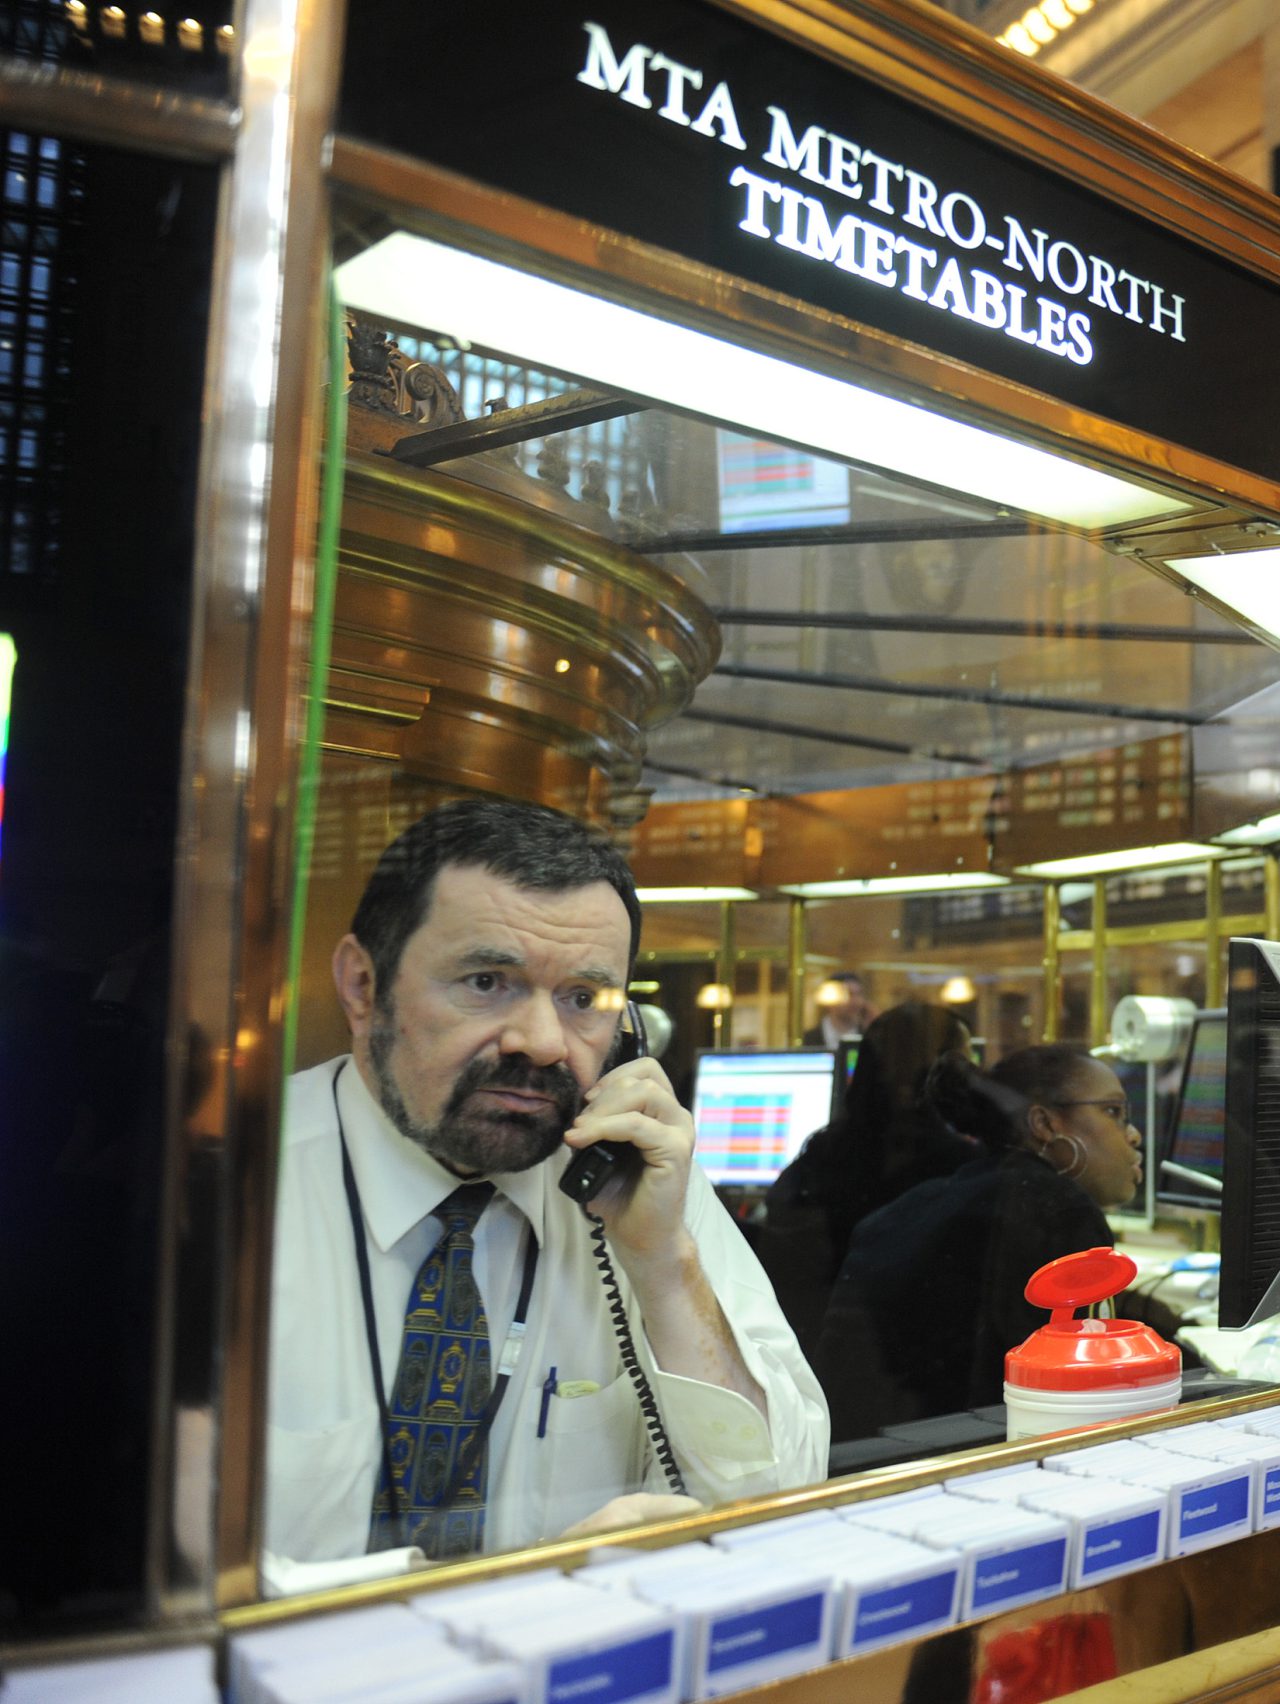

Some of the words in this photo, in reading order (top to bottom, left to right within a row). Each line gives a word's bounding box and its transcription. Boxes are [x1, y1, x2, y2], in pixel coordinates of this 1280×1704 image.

[578, 23, 747, 151] MTA
[763, 106, 1187, 343] METRO-NORTH
[729, 166, 1094, 366] TIMETABLES
